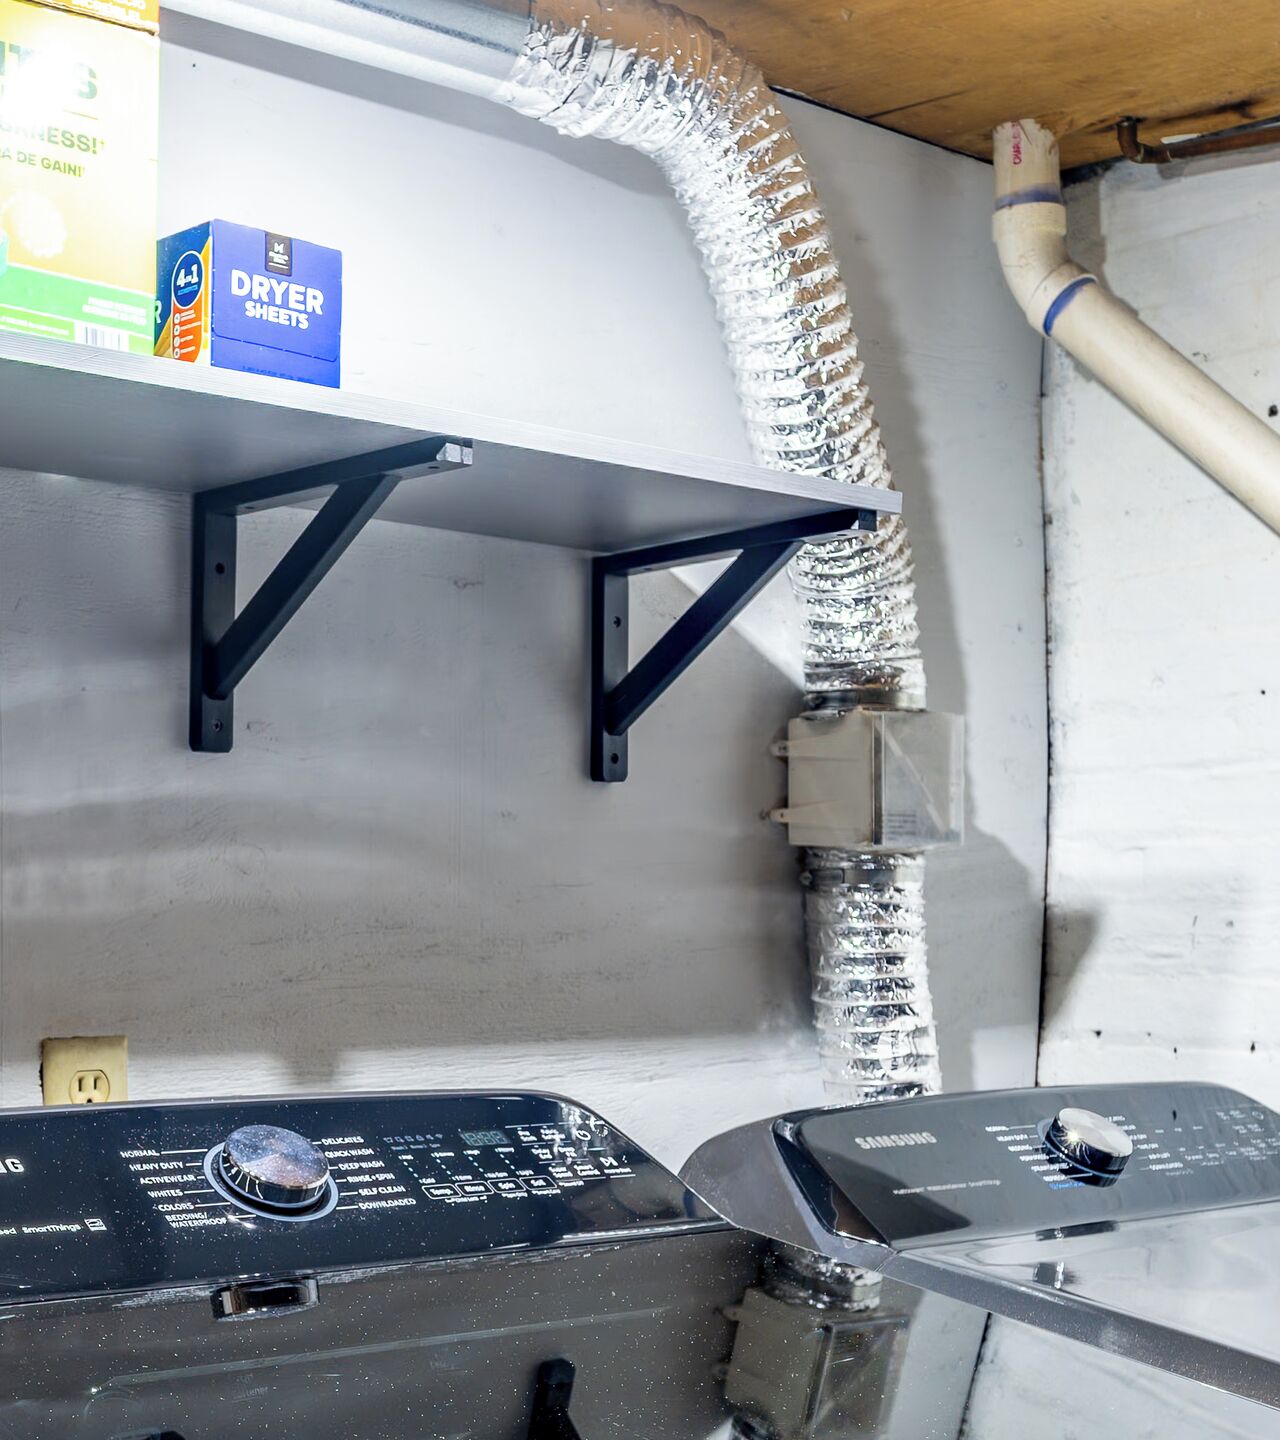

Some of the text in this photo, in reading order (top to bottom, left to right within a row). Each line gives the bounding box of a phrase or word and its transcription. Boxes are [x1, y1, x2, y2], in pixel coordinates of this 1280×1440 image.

[16, 149, 37, 167] DE
[230, 268, 325, 316] DRYER
[244, 300, 310, 330] SHEETS
[321, 1136, 365, 1146] DELICATES
[854, 1131, 938, 1150] SAMSUNG
[120, 1149, 161, 1159] NORMAL
[324, 1148, 375, 1158] QUICK WASH
[128, 1161, 184, 1172] HEAVY DUTY
[338, 1160, 385, 1171] DEEP WASH
[139, 1175, 197, 1185] ACTIVEWEAR
[147, 1189, 184, 1199] WHITES
[358, 1185, 406, 1197] SELF CLEAN
[157, 1202, 195, 1212] COLORS
[358, 1197, 417, 1210] DOWNLOADED
[164, 1212, 208, 1222] BEDDING/
[169, 1217, 227, 1229] WATERPROOF
